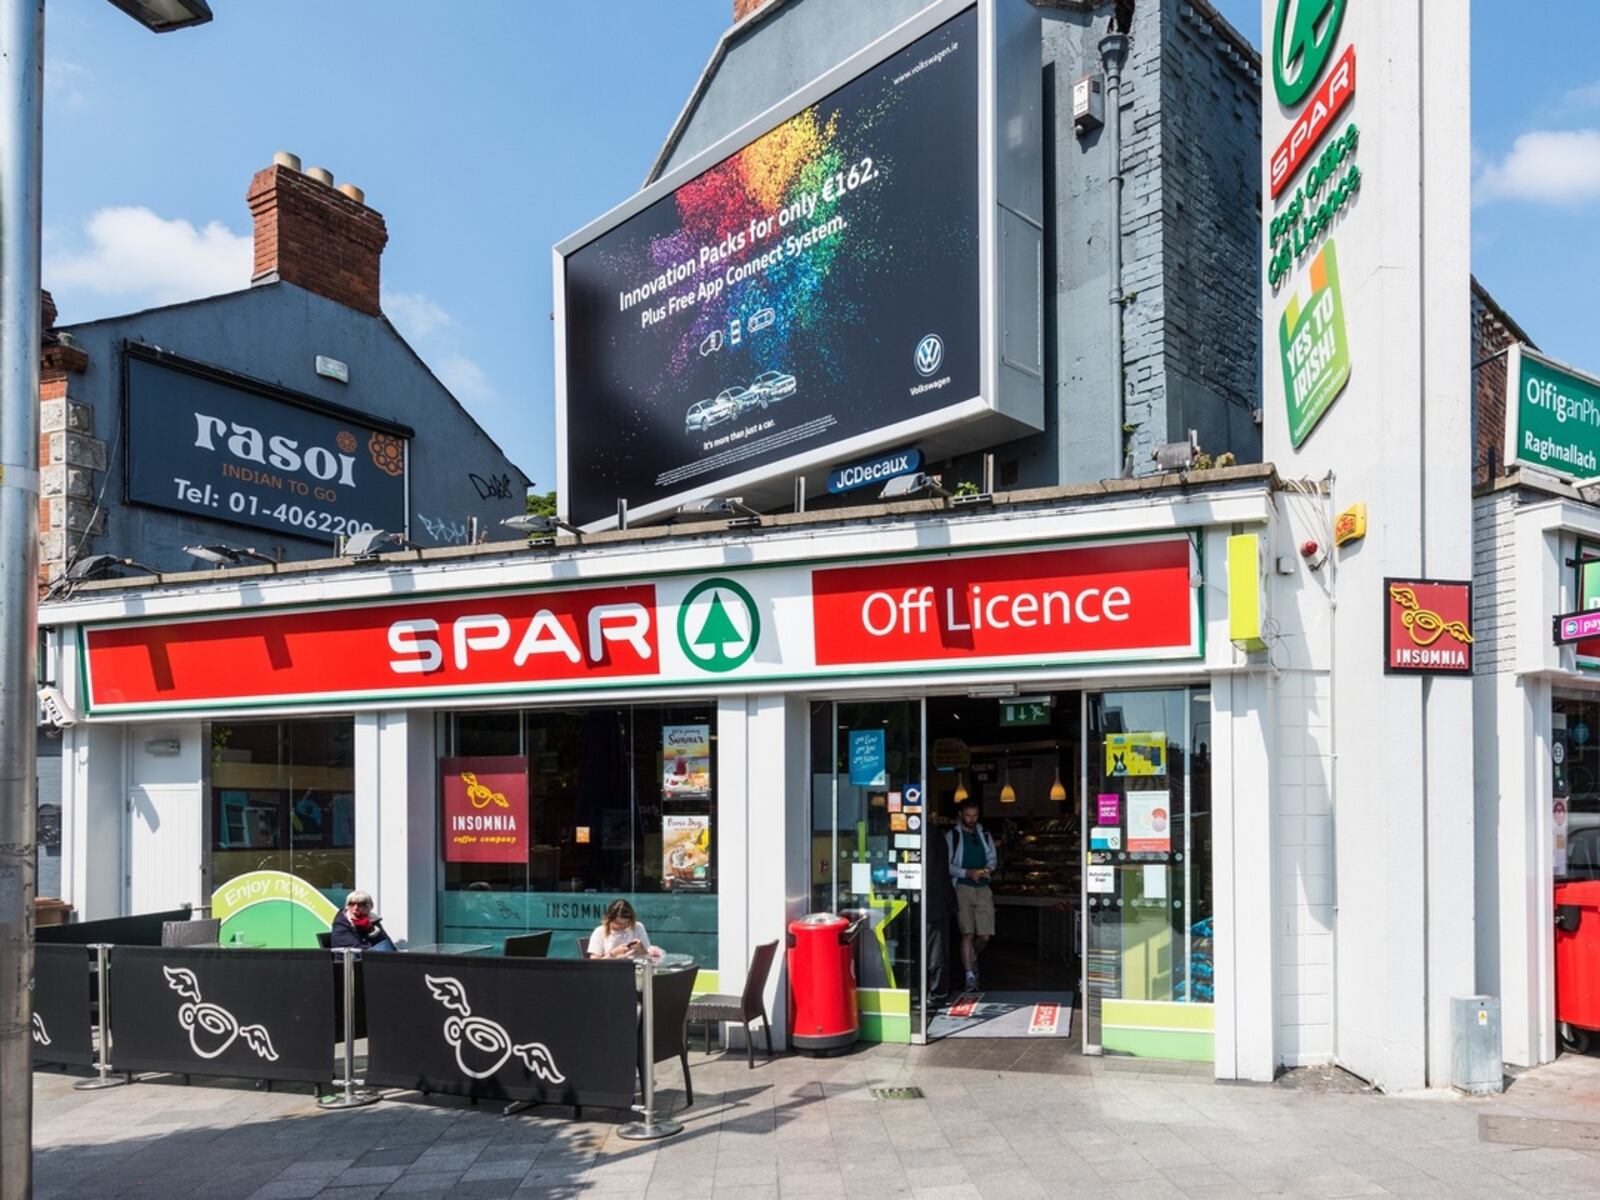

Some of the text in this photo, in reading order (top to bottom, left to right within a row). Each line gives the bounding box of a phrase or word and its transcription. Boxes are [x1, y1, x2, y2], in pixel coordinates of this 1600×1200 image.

[1272, 61, 1349, 187] SPAR
[1270, 123, 1359, 249] Post Office
[619, 157, 880, 311] Innovation Packs for only €162.
[1268, 164, 1361, 286] Off Licence
[640, 214, 848, 328] Plus Free App Connect System.
[1286, 286, 1335, 377] YES TO
[909, 376, 951, 396] Volkswagen
[1292, 323, 1337, 409] IRISH!
[193, 412, 356, 488] rasoi
[712, 435, 730, 447] more
[730, 429, 745, 441] than
[743, 424, 758, 439] just
[1524, 430, 1596, 470] Raghnallach
[222, 463, 337, 503] INDIAN TO GO
[836, 454, 909, 489] JCDecaux
[173, 477, 219, 508] Tel:
[861, 585, 1131, 637] Off Licence
[387, 602, 652, 674] SPAR
[1396, 648, 1465, 665] INSOMNIA
[452, 815, 516, 831] INSOMNIA
[453, 836, 516, 844] coffee company
[224, 878, 272, 907] Enjoy
[546, 903, 607, 919] INSOMNI
